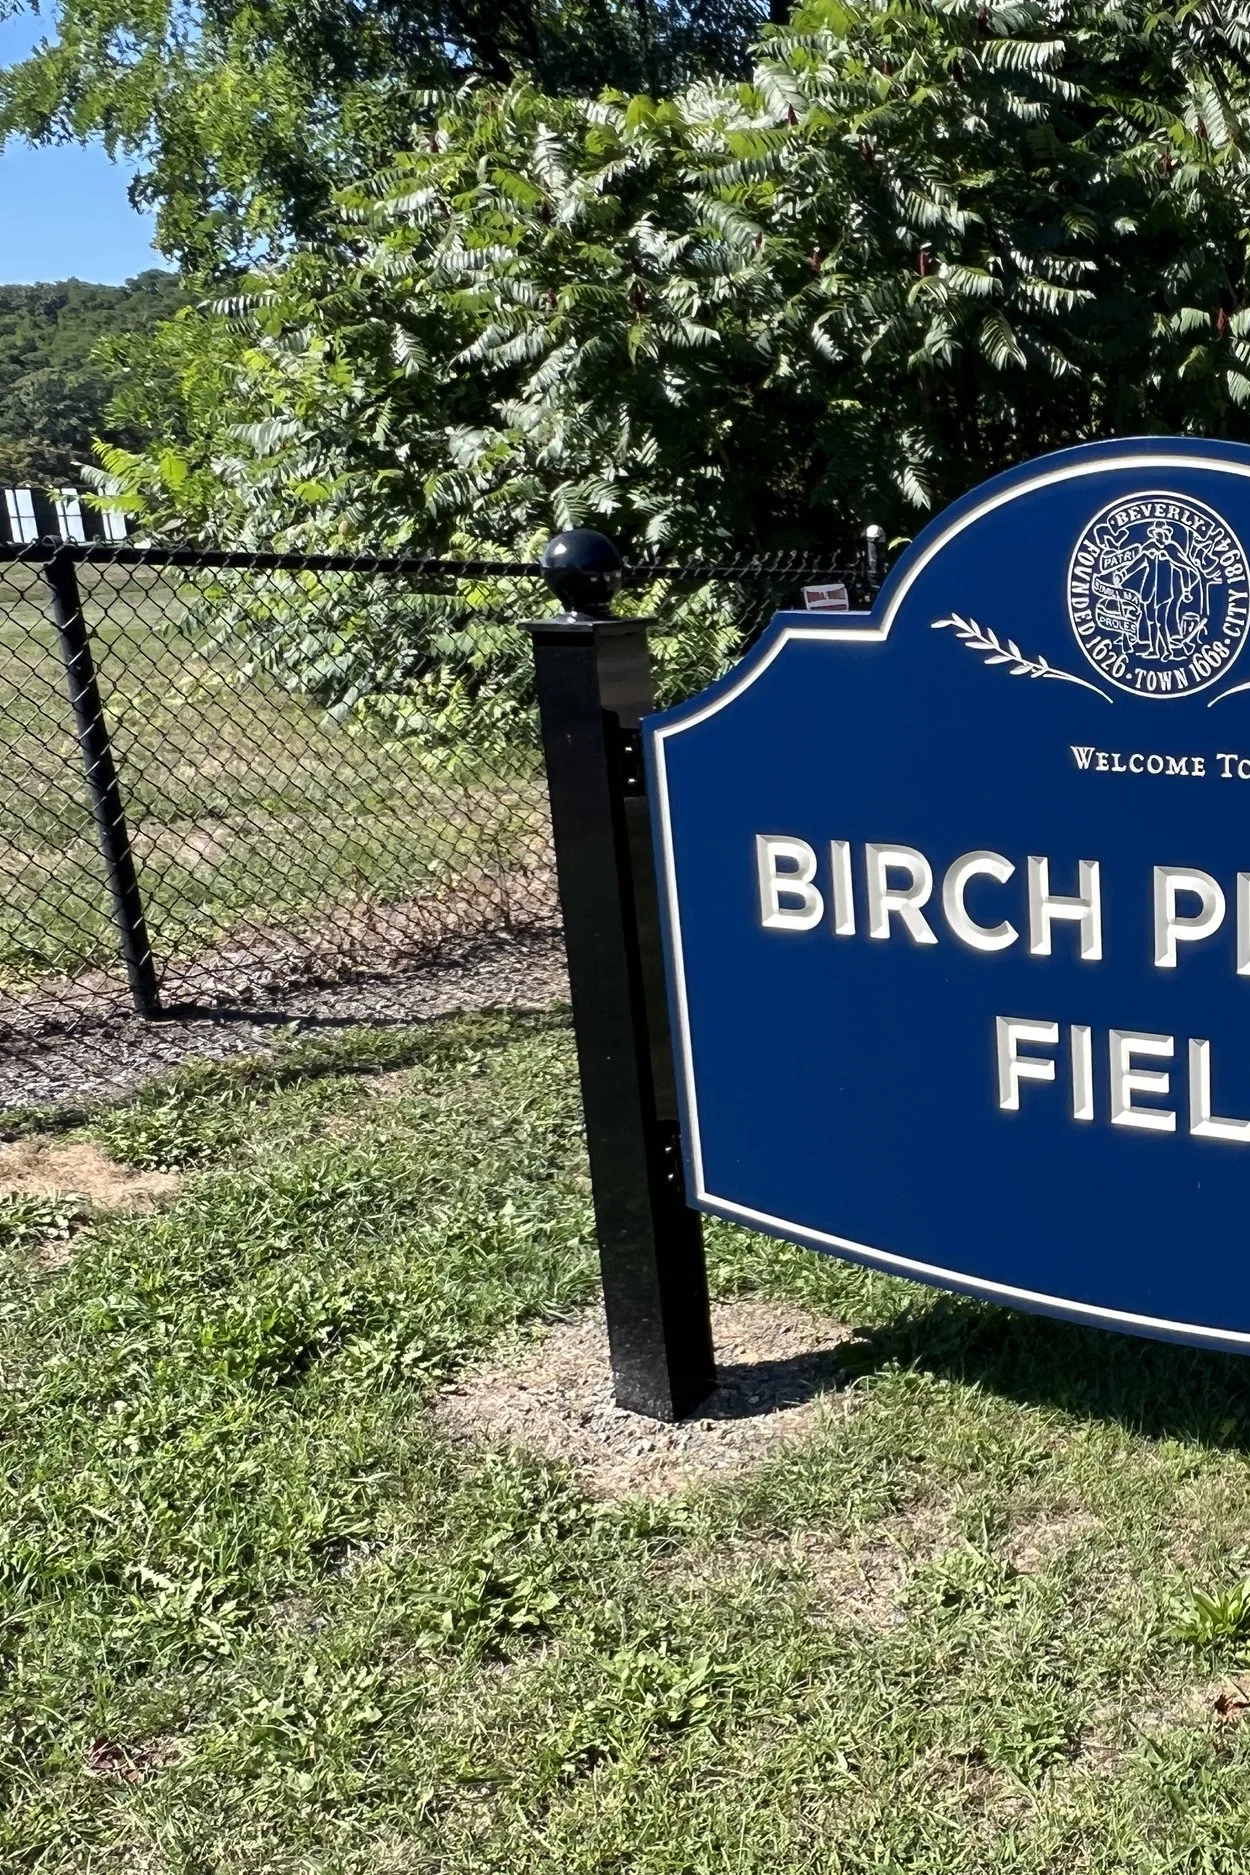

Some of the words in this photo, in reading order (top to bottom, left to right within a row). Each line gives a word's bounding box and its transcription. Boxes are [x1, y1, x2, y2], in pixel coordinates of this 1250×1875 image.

[1116, 503, 1204, 531] BEVERLY
[1085, 637, 1129, 680] 1626
[1135, 668, 1189, 691] TOWN
[1188, 641, 1230, 681] 1668
[1222, 590, 1248, 638] CITY
[756, 834, 1103, 960] BIRCH
